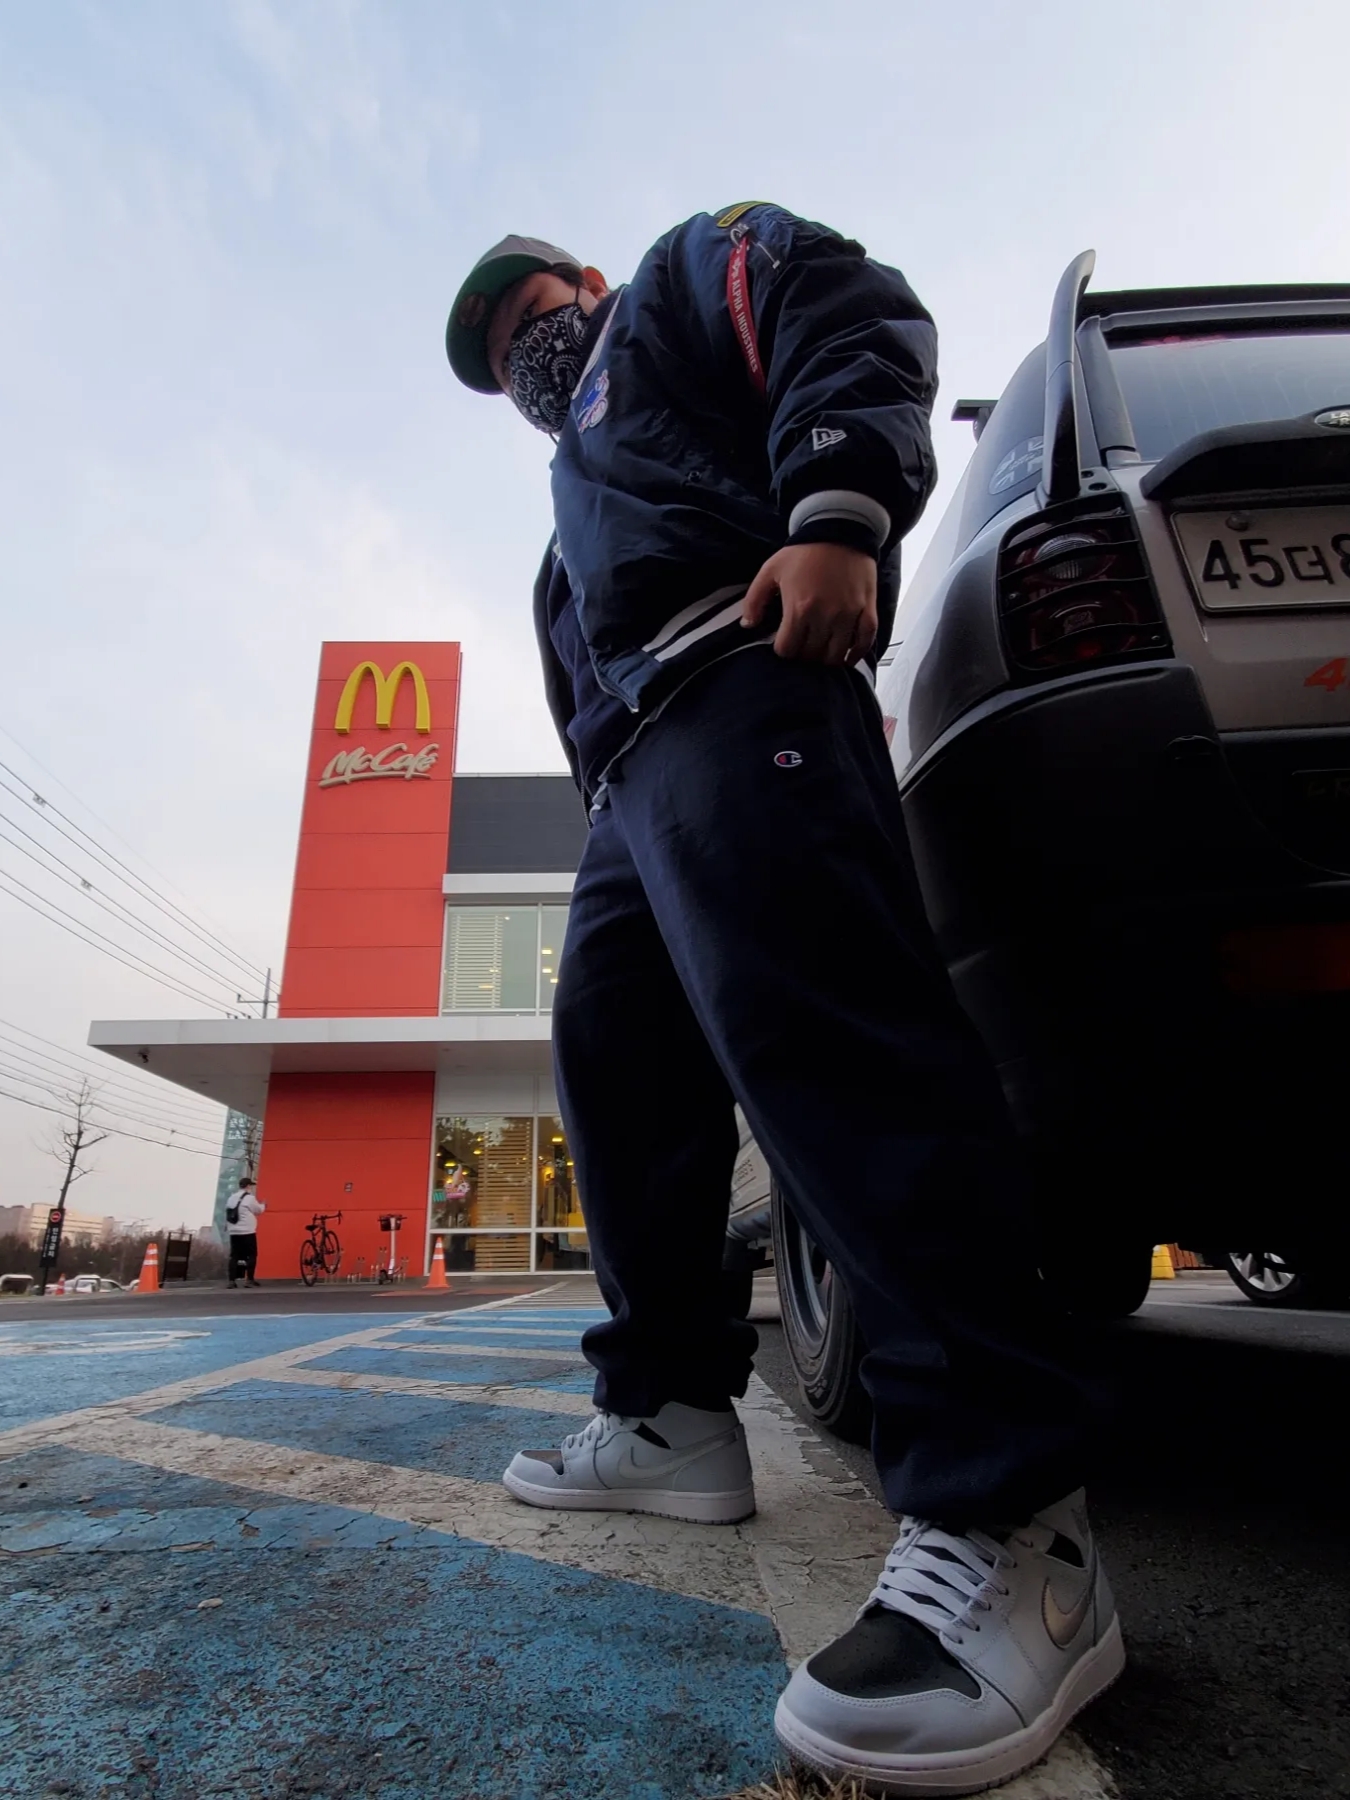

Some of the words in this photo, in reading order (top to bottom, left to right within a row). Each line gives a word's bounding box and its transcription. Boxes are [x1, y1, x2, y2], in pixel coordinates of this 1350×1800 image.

[732, 279, 743, 312] ALPHA
[737, 311, 758, 373] INDUSTRIES
[1304, 657, 1350, 692] 4
